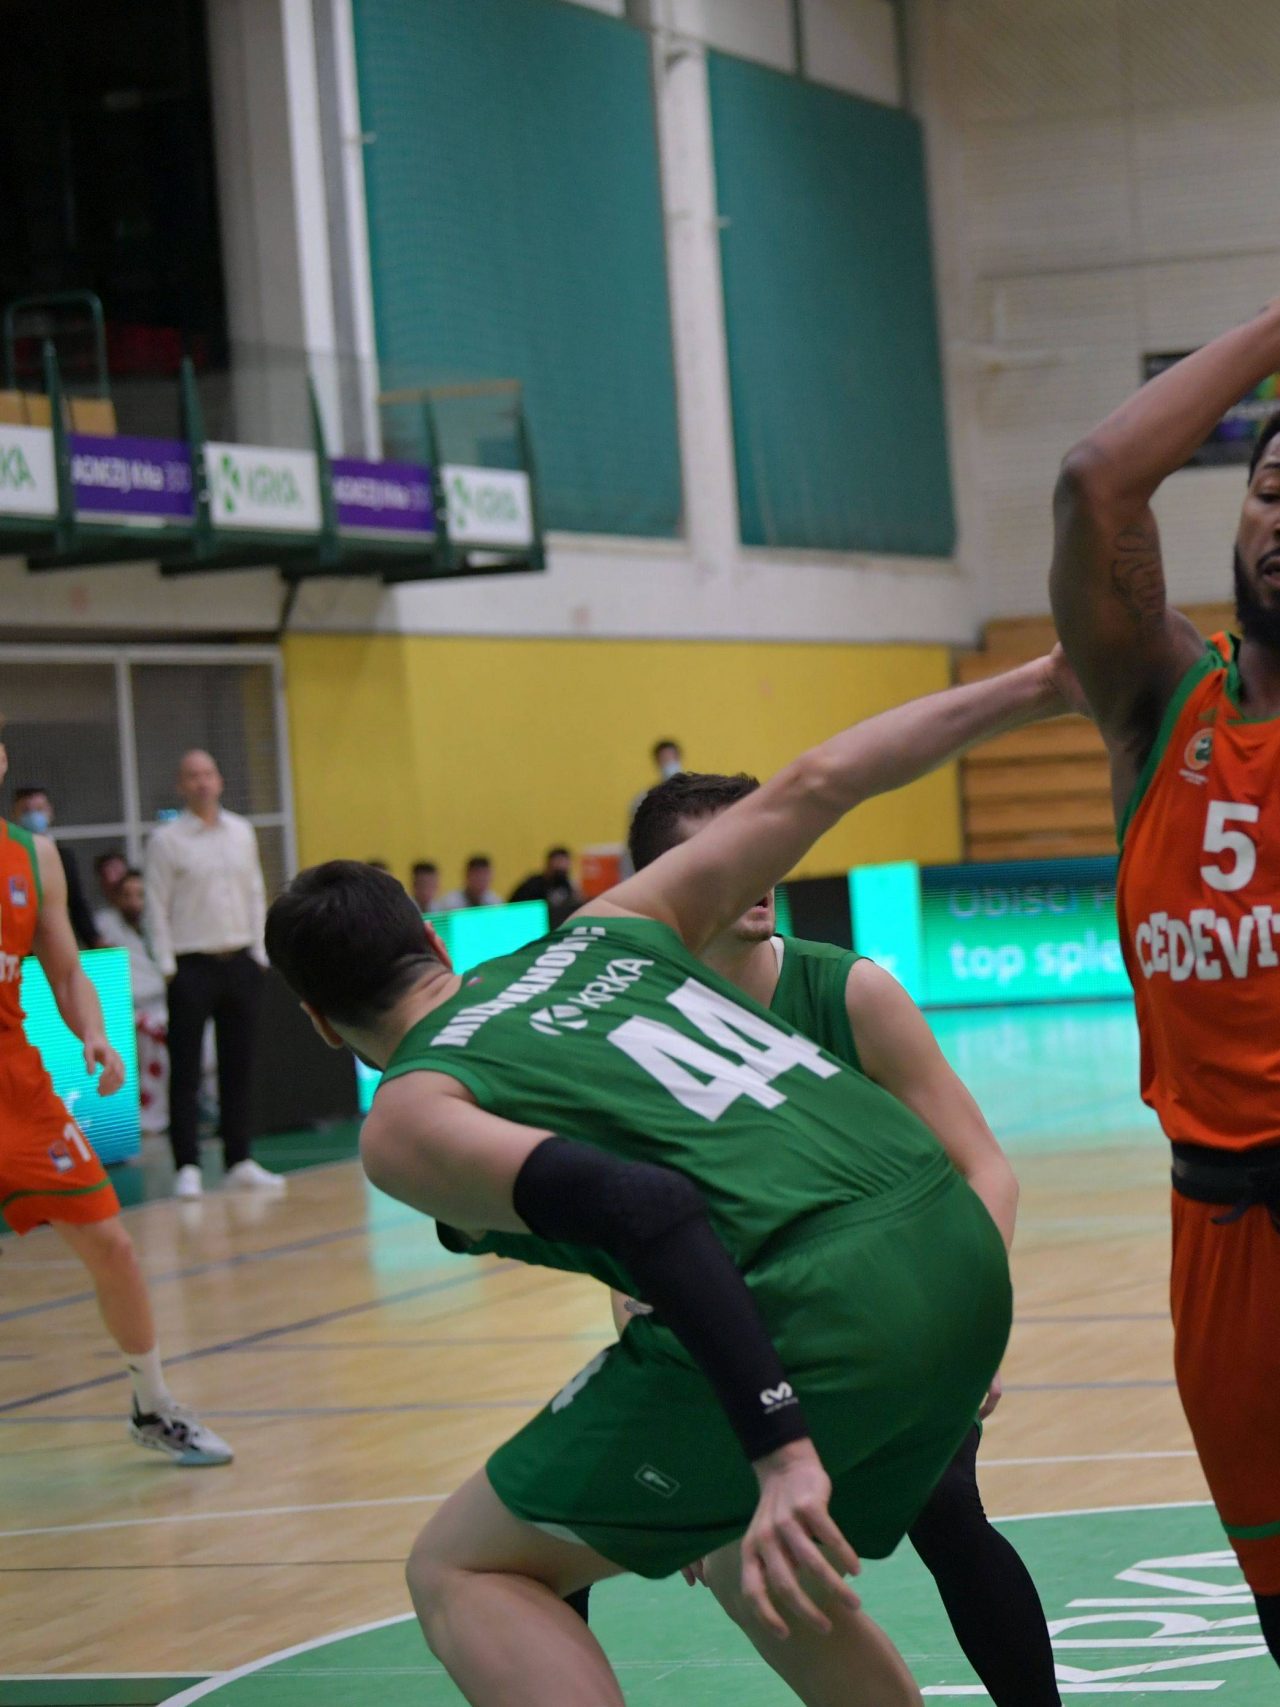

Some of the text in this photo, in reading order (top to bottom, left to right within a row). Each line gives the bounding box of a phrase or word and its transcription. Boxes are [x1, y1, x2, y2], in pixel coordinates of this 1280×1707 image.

[1201, 800, 1259, 892] 5
[567, 958, 654, 1009] KRKA
[951, 941, 1026, 987] top
[607, 977, 841, 1122] 44
